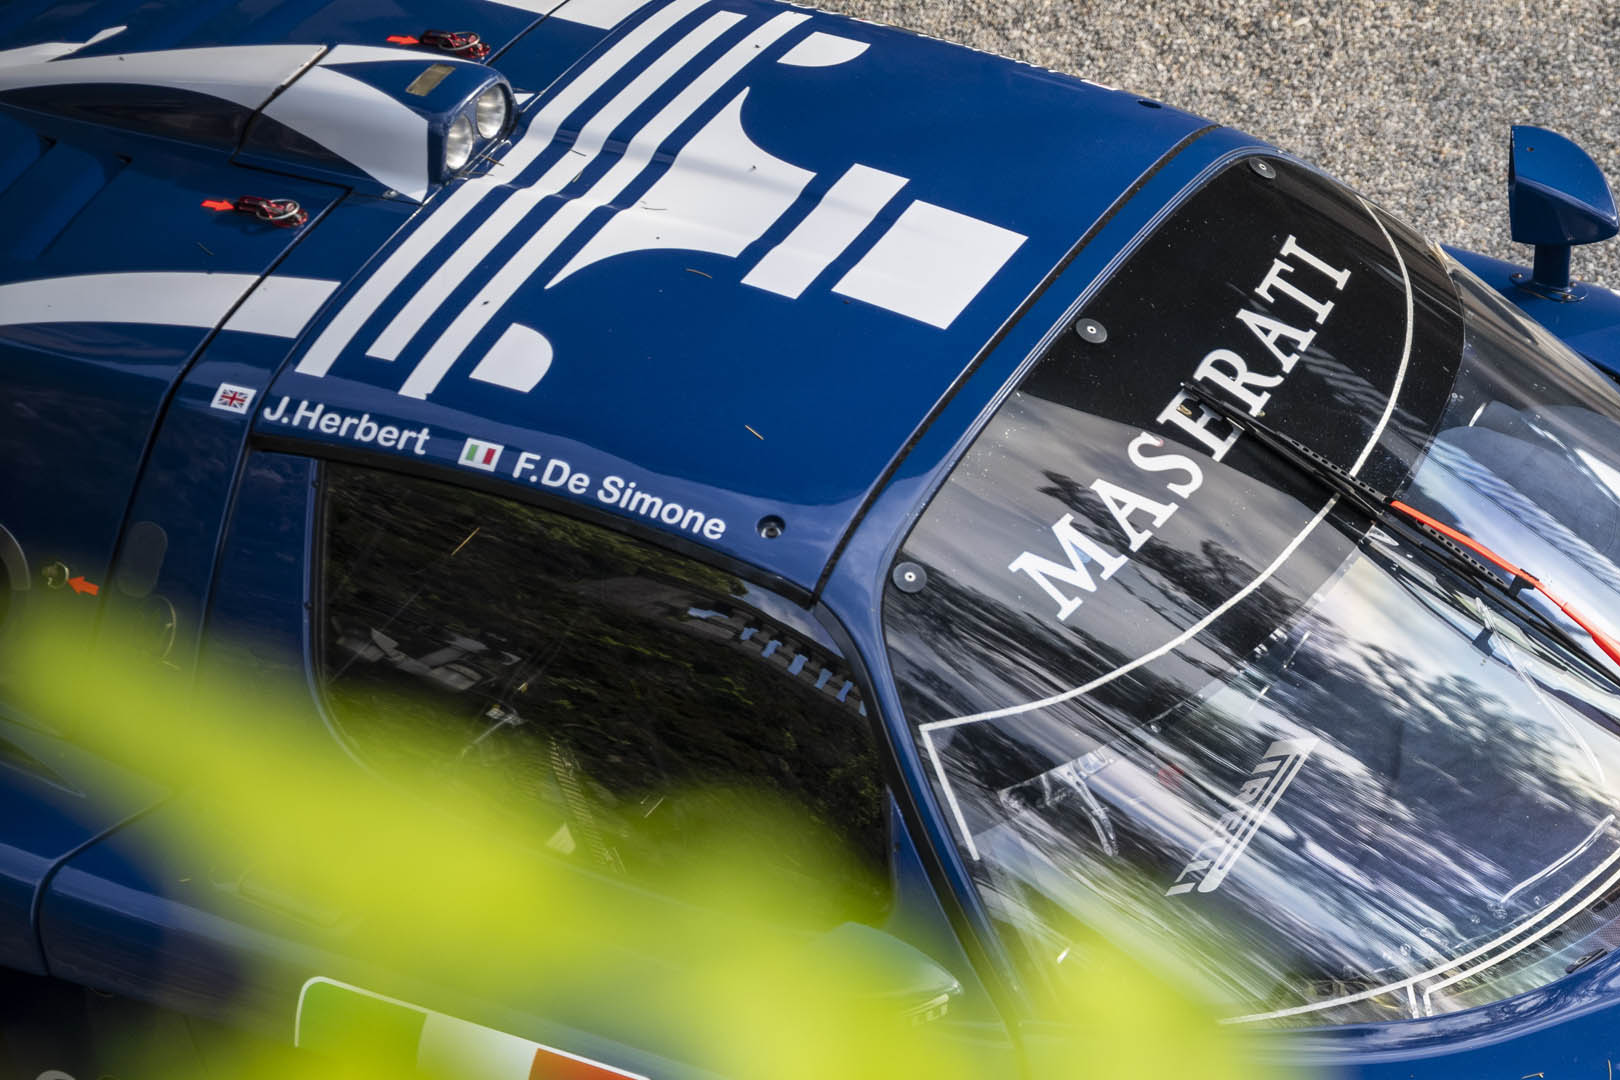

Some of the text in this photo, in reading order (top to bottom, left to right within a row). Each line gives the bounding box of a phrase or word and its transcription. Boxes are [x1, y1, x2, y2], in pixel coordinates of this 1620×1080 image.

[263, 396, 430, 455] J.Herbert
[1008, 235, 1351, 621] MASERATI
[512, 452, 726, 540] F.De Simone
[1164, 738, 1320, 896] PIRELLI
